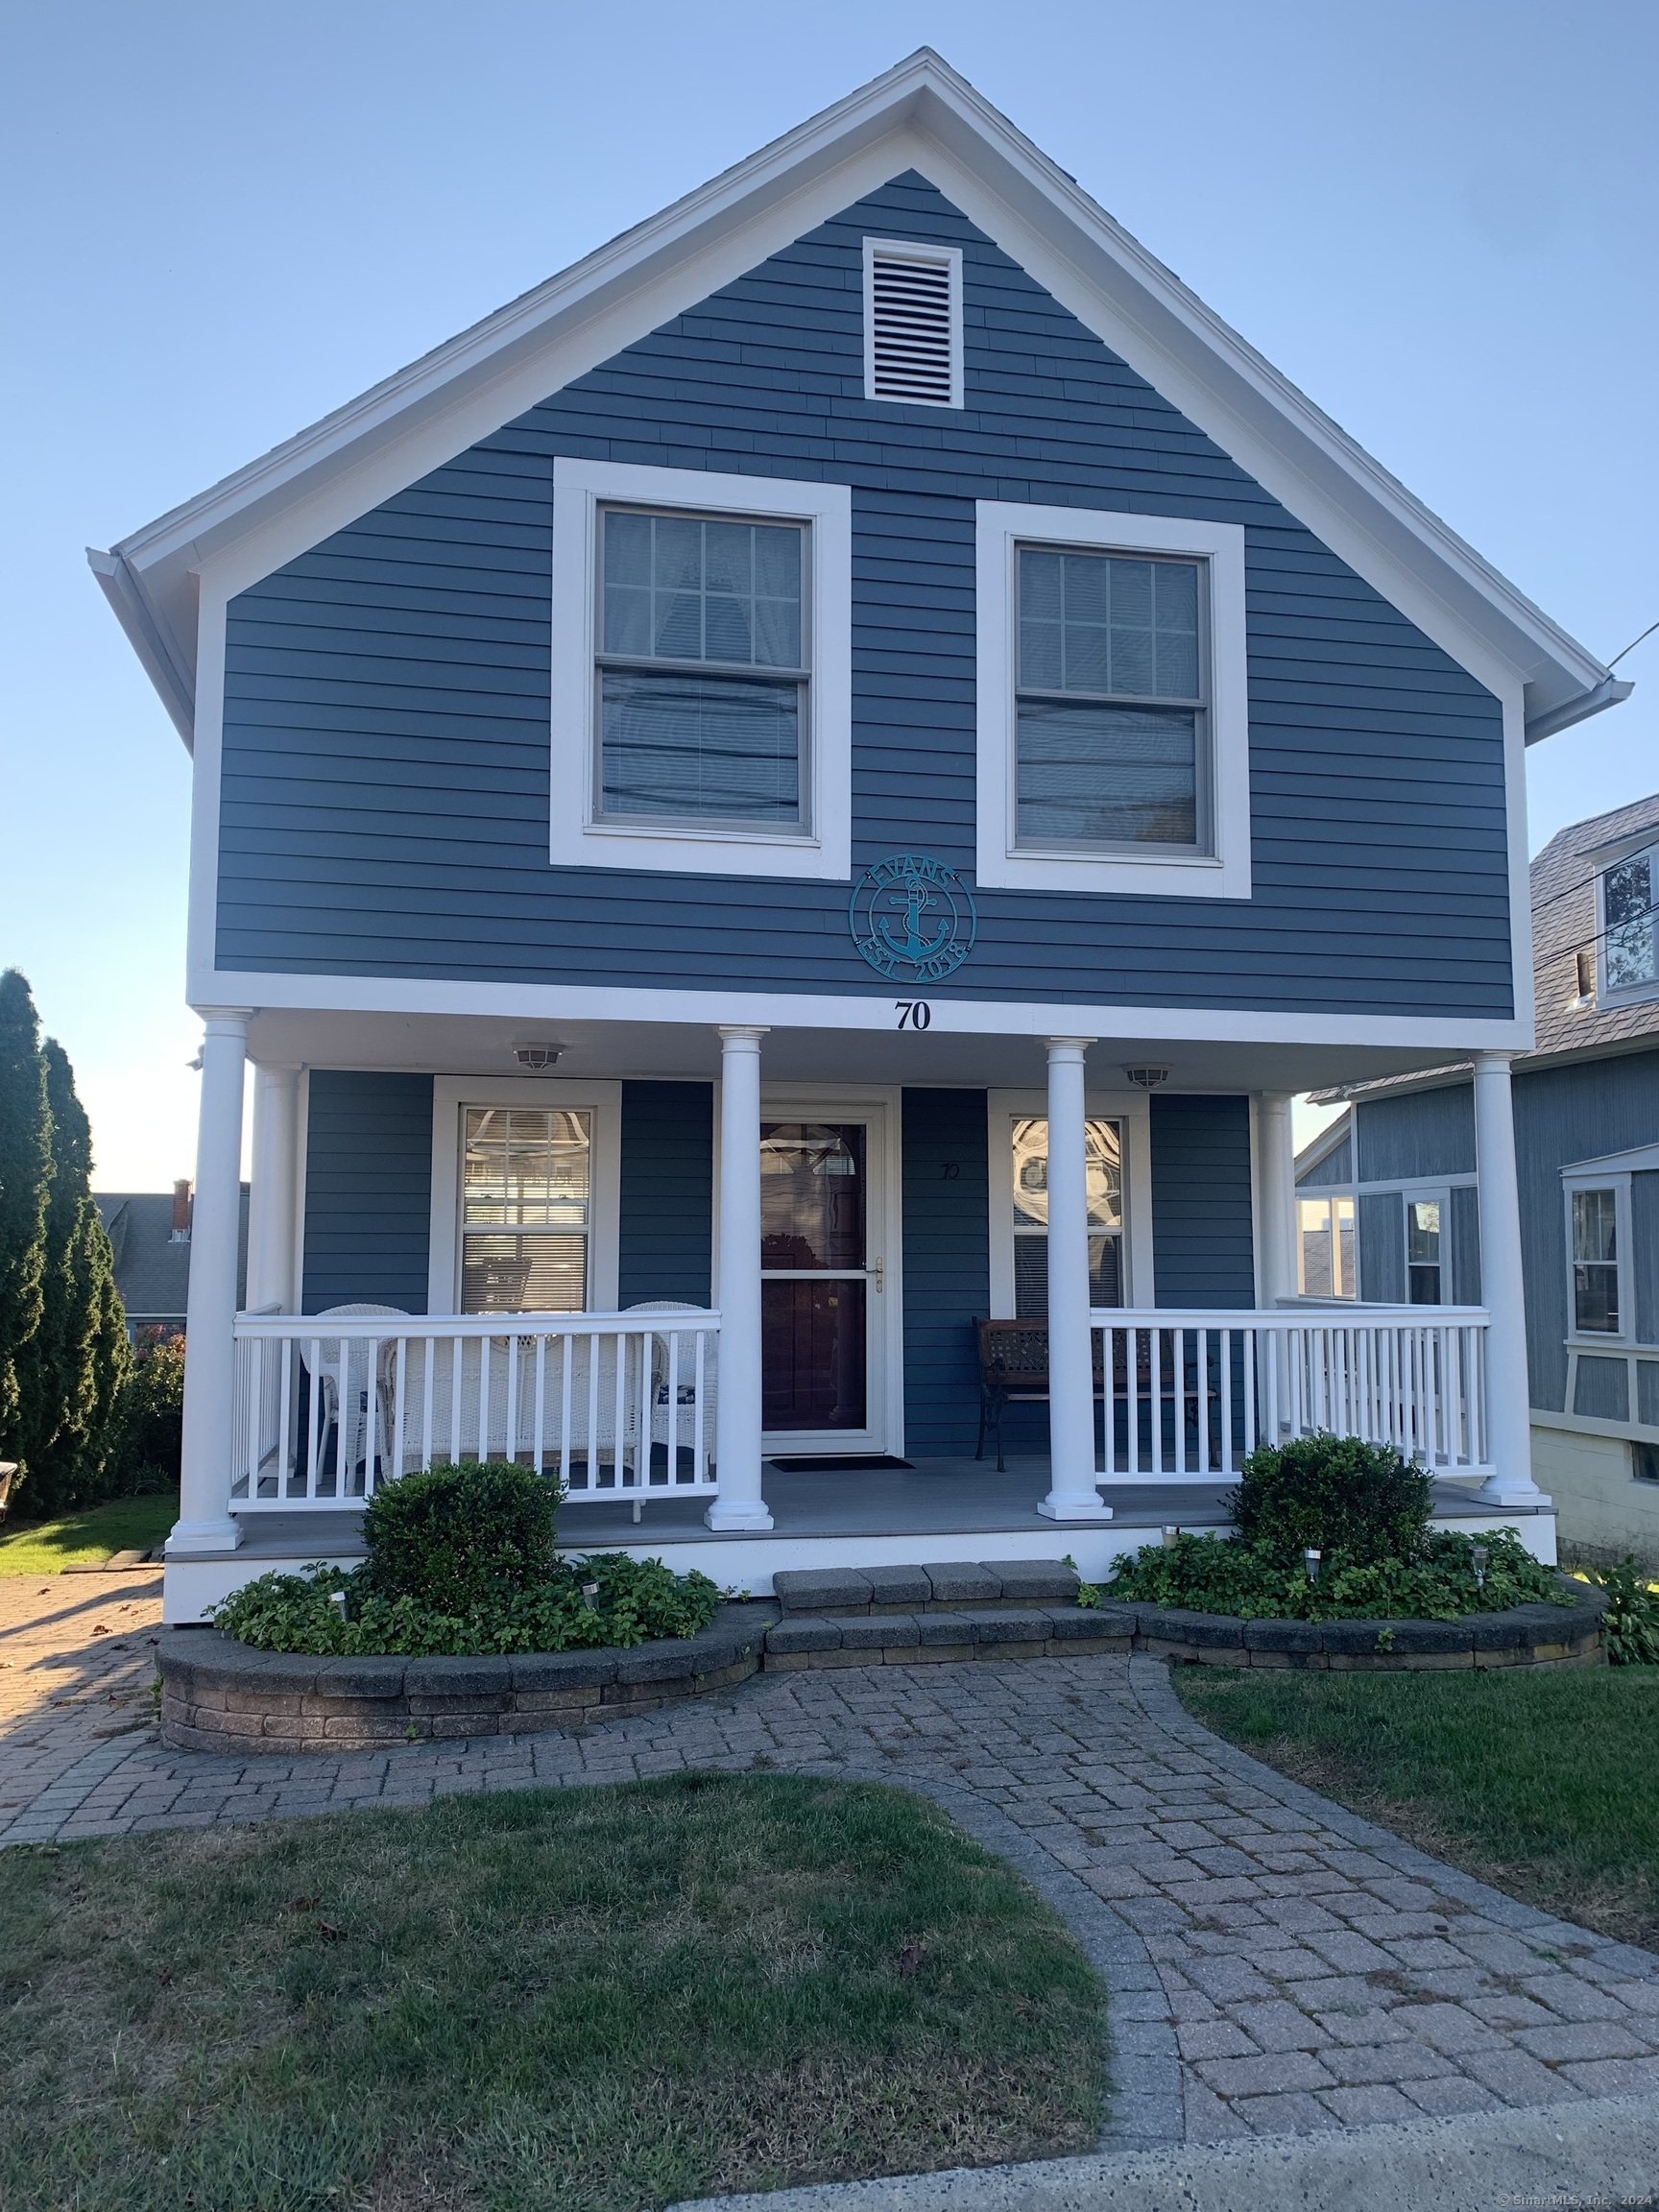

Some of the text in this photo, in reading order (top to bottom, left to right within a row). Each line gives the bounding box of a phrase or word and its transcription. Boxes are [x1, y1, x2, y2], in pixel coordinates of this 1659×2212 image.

[870, 854, 953, 888] EVANS
[914, 941, 966, 980] 2018
[895, 1000, 931, 1030] 70
[940, 1163, 960, 1181] 70
